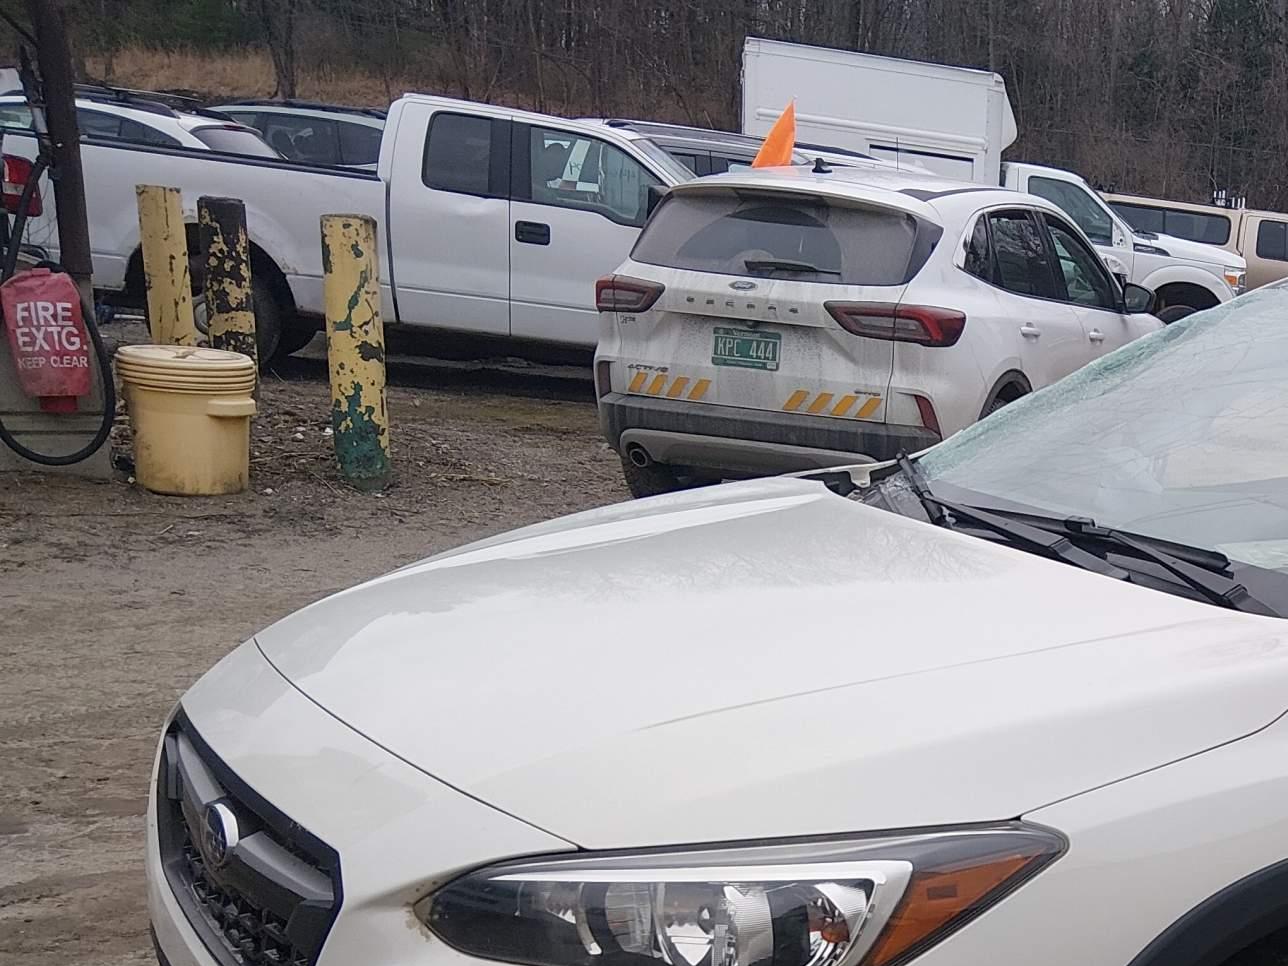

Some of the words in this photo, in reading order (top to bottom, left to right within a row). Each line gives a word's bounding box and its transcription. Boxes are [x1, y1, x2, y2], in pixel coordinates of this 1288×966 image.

[16, 301, 74, 326] FIRE
[15, 326, 88, 351] EXTG.
[717, 337, 741, 357] KPC
[749, 340, 774, 360] 444
[17, 356, 46, 368] KEEP
[50, 356, 88, 368] CLEAR
